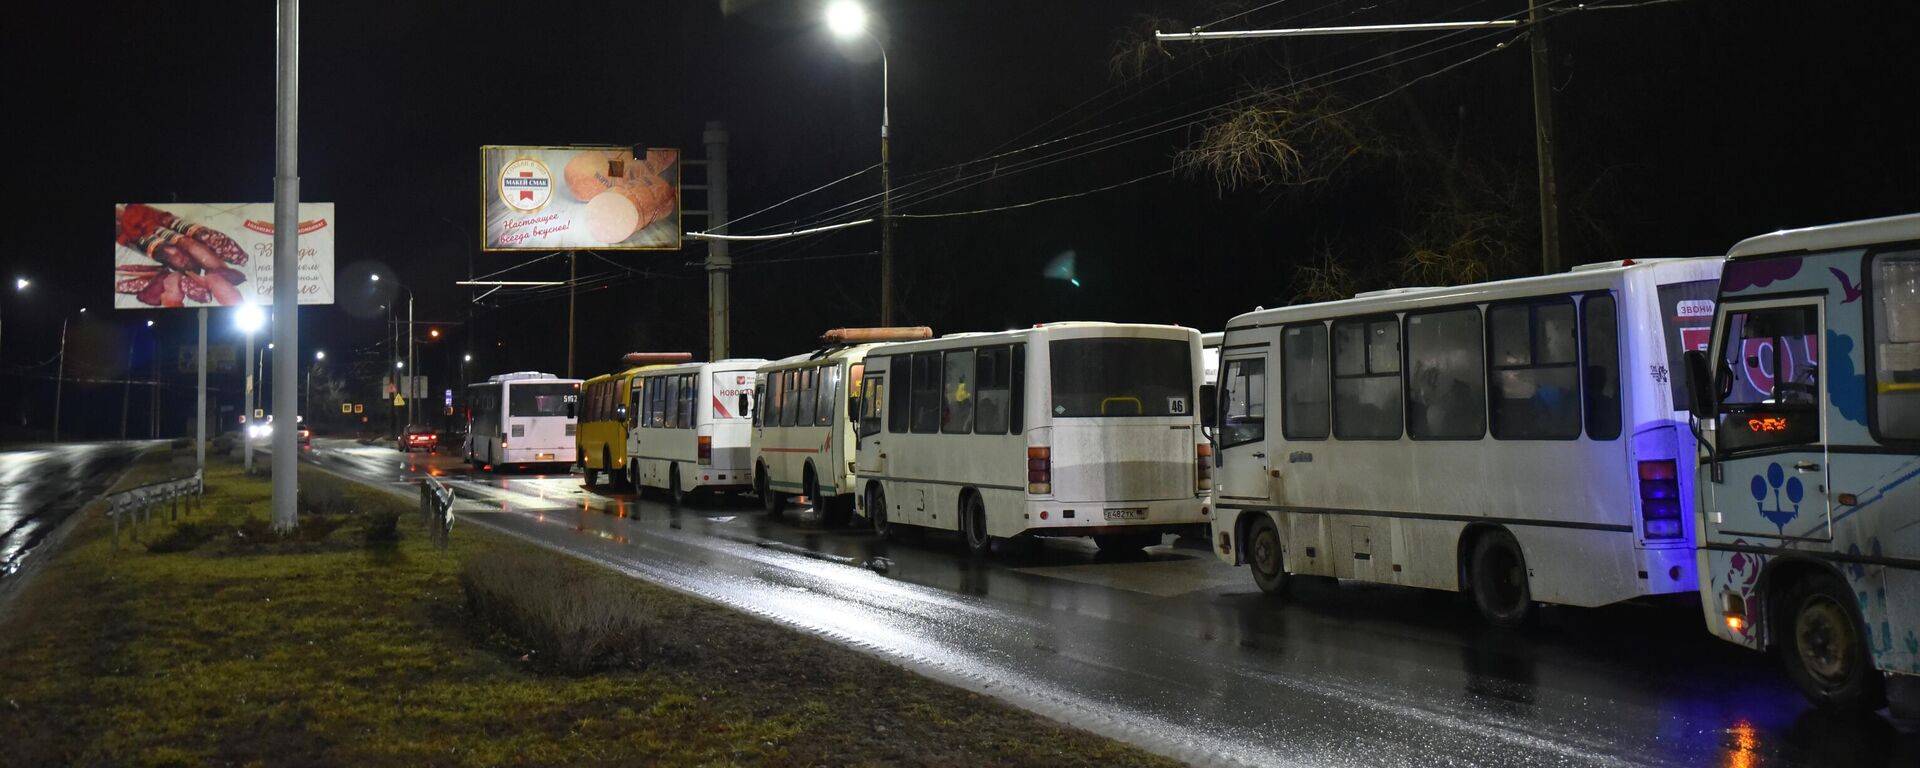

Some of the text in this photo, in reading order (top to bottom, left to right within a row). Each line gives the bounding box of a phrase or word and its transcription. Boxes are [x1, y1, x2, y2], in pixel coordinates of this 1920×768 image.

[503, 213, 559, 230] Настоящее
[500, 219, 571, 244] всегда вкуснее!
[1680, 305, 1713, 314] ЗВОНИ
[1171, 399, 1183, 413] 46
